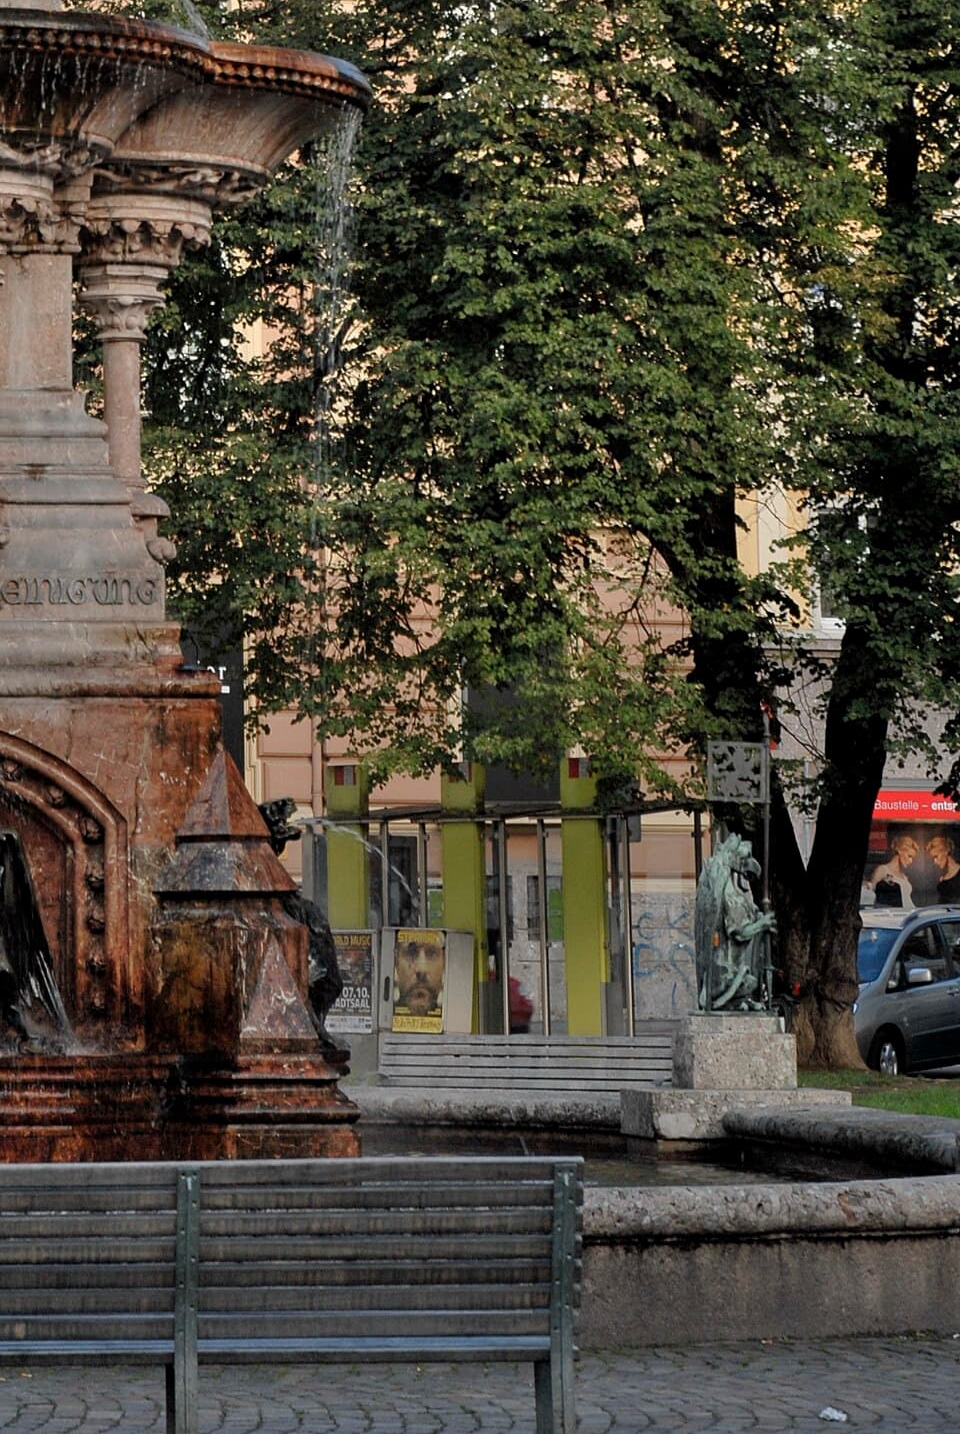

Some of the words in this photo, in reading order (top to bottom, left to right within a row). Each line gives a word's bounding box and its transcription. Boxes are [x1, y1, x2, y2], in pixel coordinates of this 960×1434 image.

[874, 799, 919, 810] Baustelle
[342, 987, 370, 998] 07.10.
[331, 997, 371, 1009] ADTSAAL
